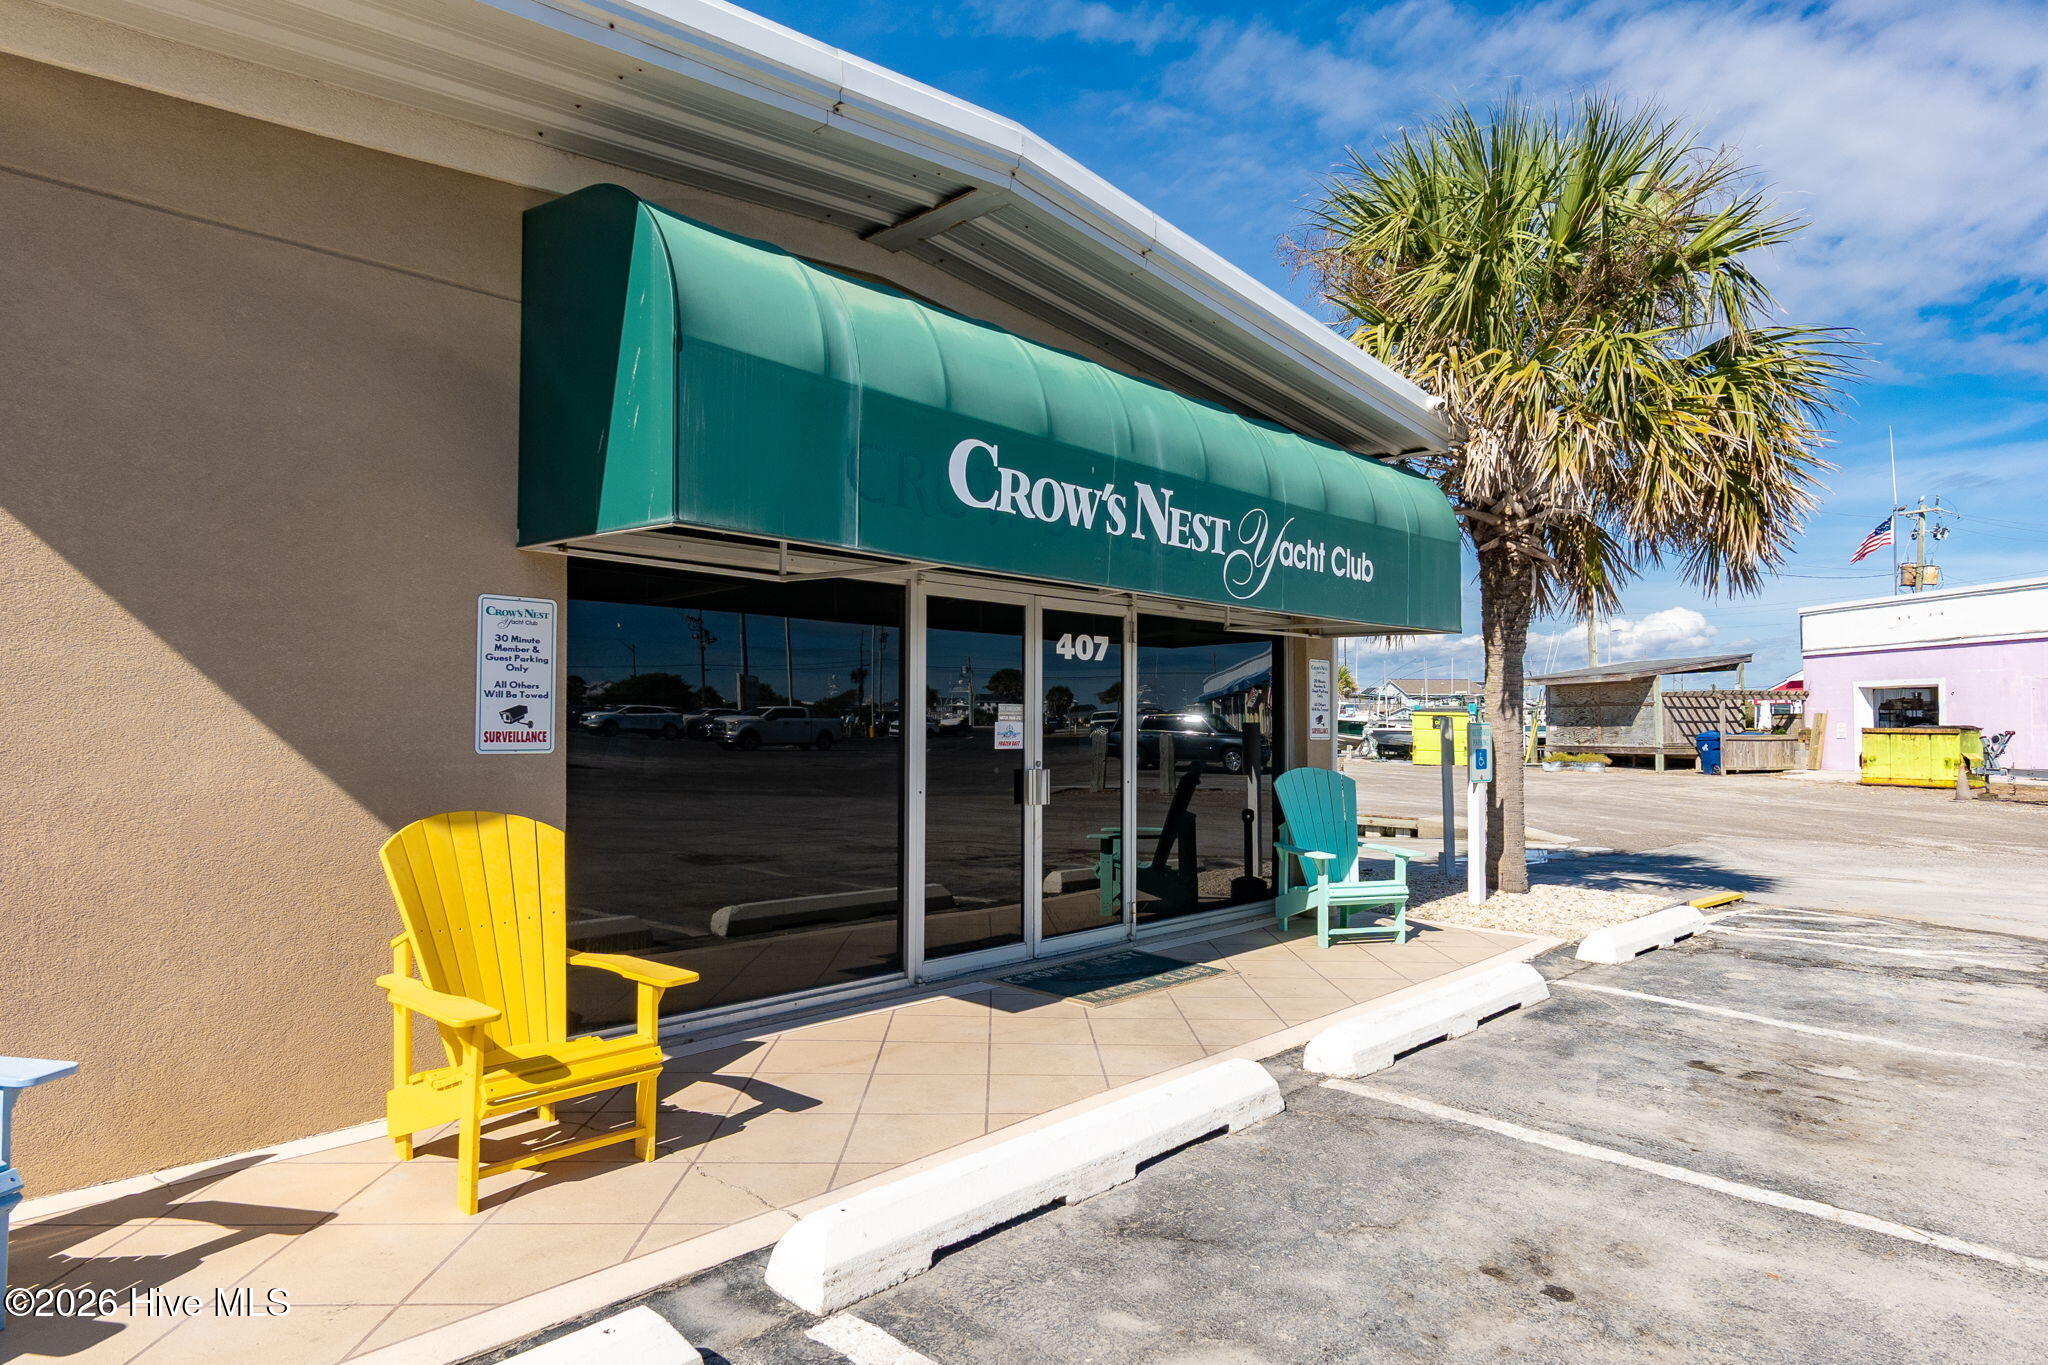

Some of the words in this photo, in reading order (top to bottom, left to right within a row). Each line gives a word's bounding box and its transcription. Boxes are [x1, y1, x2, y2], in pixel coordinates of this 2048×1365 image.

[1131, 481, 1231, 556] NEST
[1223, 508, 1325, 600] Yacht
[1331, 545, 1374, 583] Club
[497, 617, 524, 629] Yacht
[494, 633, 509, 642] 30
[510, 635, 541, 644] Minute
[494, 643, 530, 653] Member
[532, 645, 540, 653] &
[1056, 633, 1109, 661] 407
[485, 653, 512, 662] Guest
[514, 654, 549, 665] Parking
[505, 663, 529, 673] Only
[494, 680, 507, 689] All
[509, 680, 540, 689] Others
[483, 689, 504, 698] Will
[505, 690, 517, 699] Be
[519, 690, 549, 699] Towed
[483, 730, 548, 743] SURVEILLANCE
